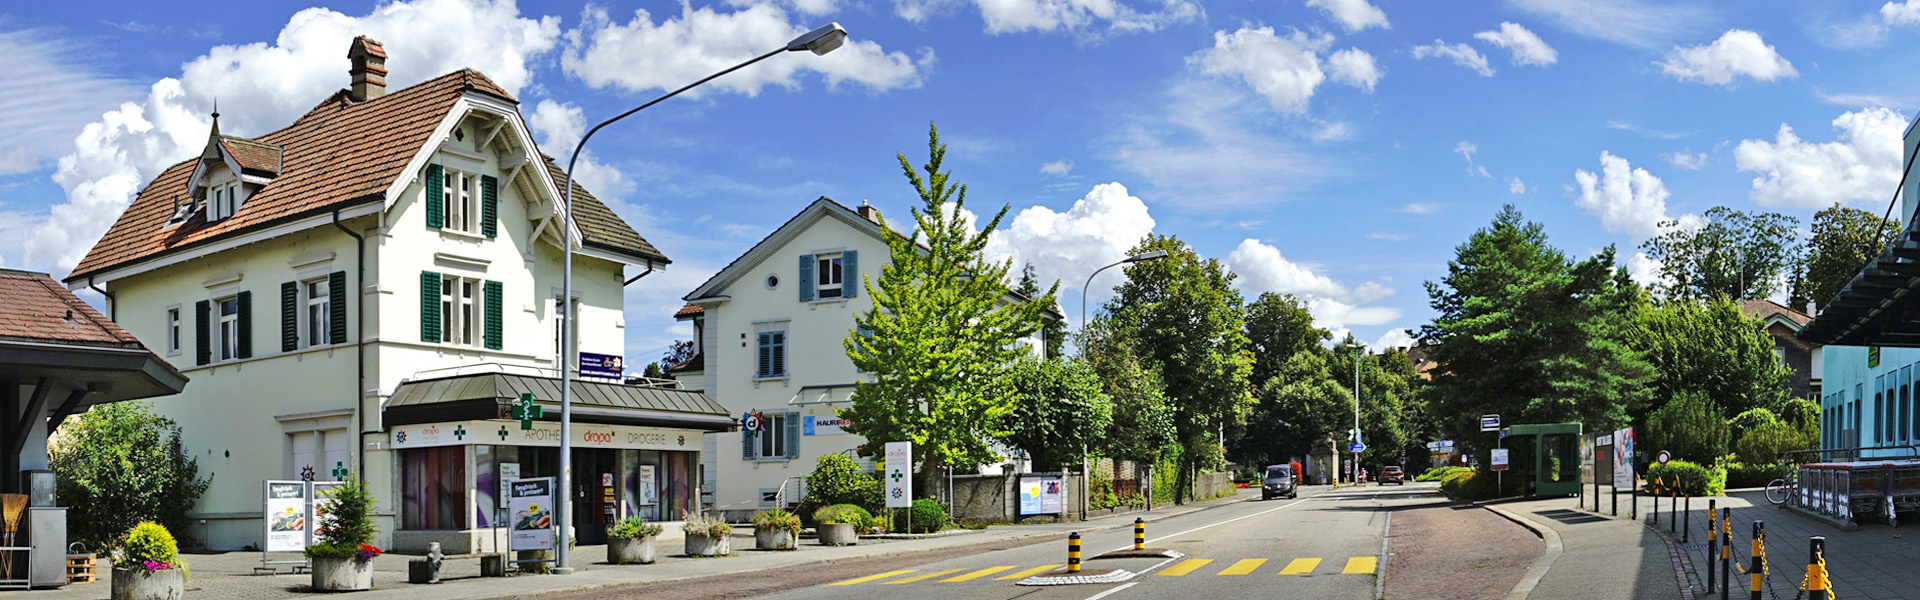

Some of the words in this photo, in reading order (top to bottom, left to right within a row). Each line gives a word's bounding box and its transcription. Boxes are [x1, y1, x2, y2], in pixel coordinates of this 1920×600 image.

[524, 428, 561, 441] APOTHE
[583, 429, 611, 445] dropa
[627, 432, 666, 445] DROGERIE
